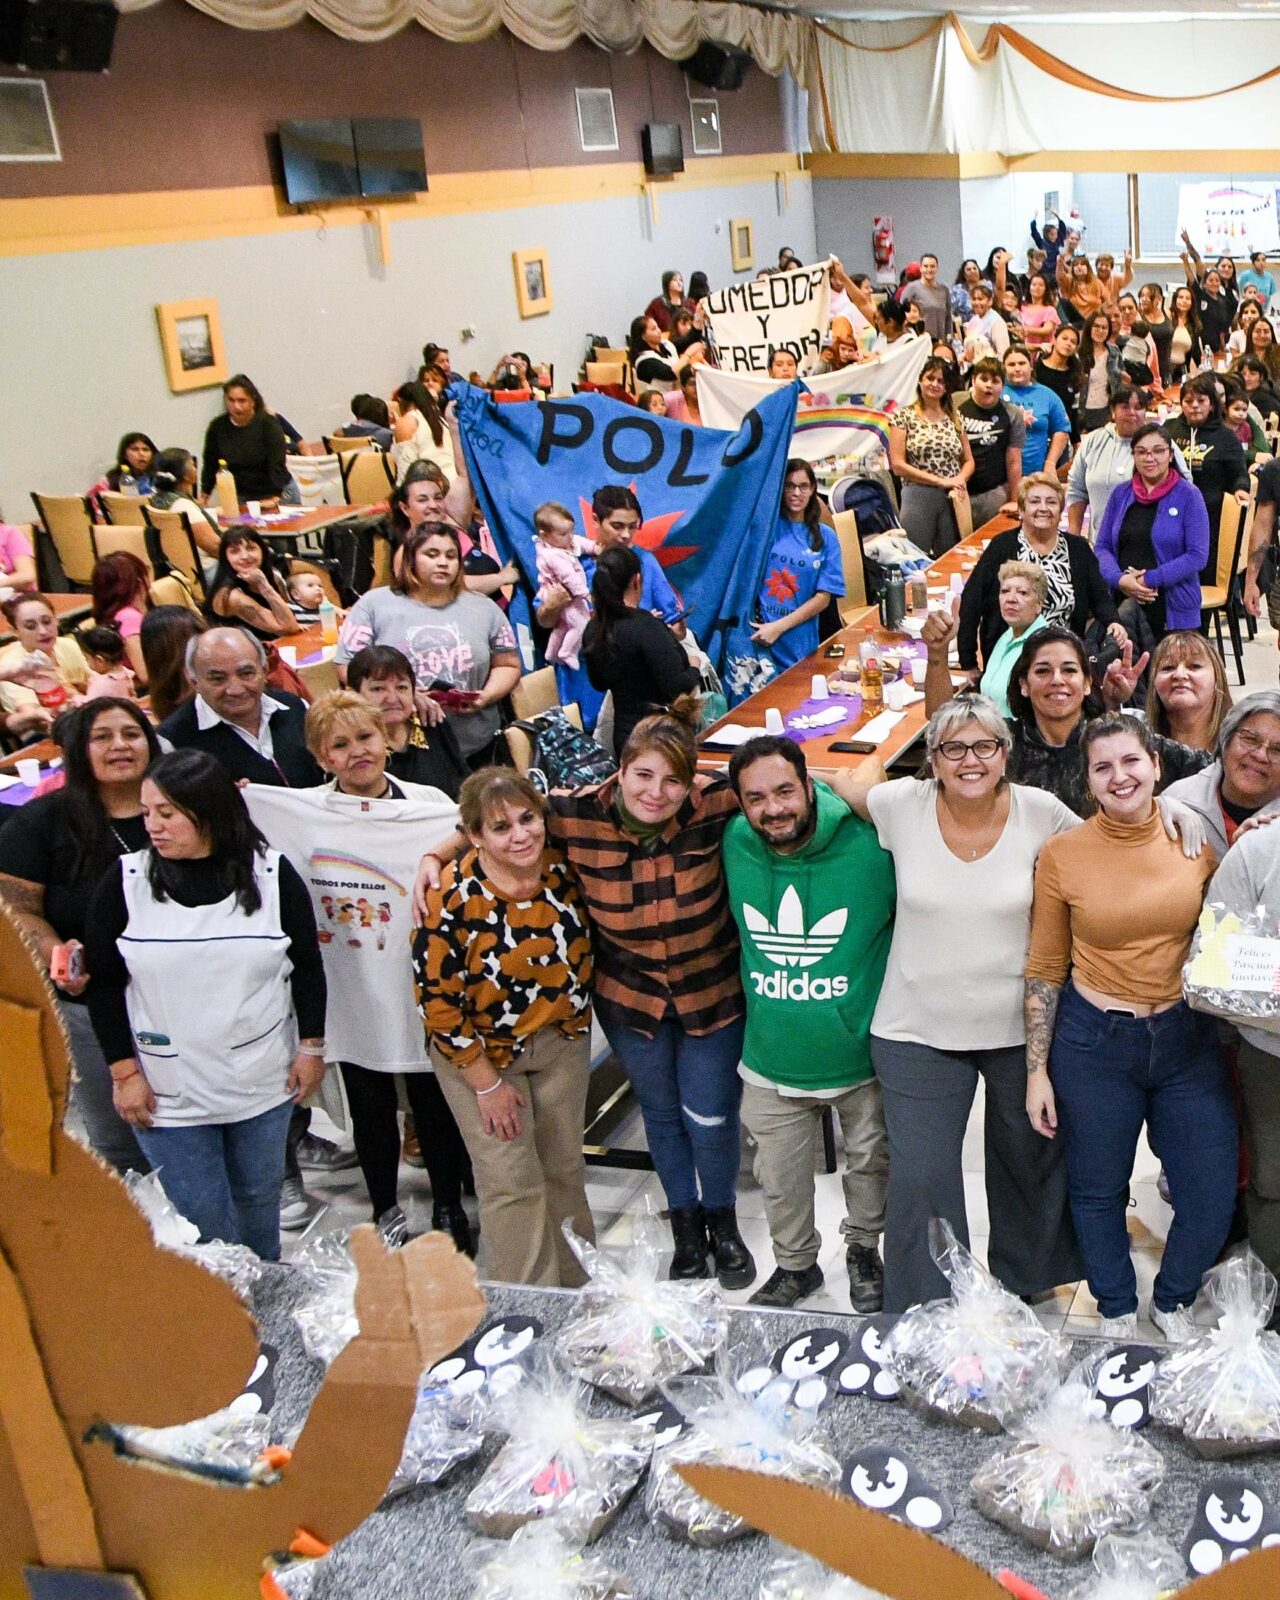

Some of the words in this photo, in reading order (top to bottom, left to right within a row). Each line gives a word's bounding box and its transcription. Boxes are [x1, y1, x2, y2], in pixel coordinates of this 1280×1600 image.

[756, 314, 770, 339] Y
[537, 400, 764, 488] POLO
[770, 553, 806, 567] POLO
[417, 643, 475, 678] LOVE
[310, 878, 339, 888] TODOS
[340, 881, 359, 889] POR
[361, 883, 387, 891] ELLOS
[1235, 946, 1271, 958] Felices
[1233, 959, 1274, 970] Pascuas
[750, 970, 849, 1001] adidas
